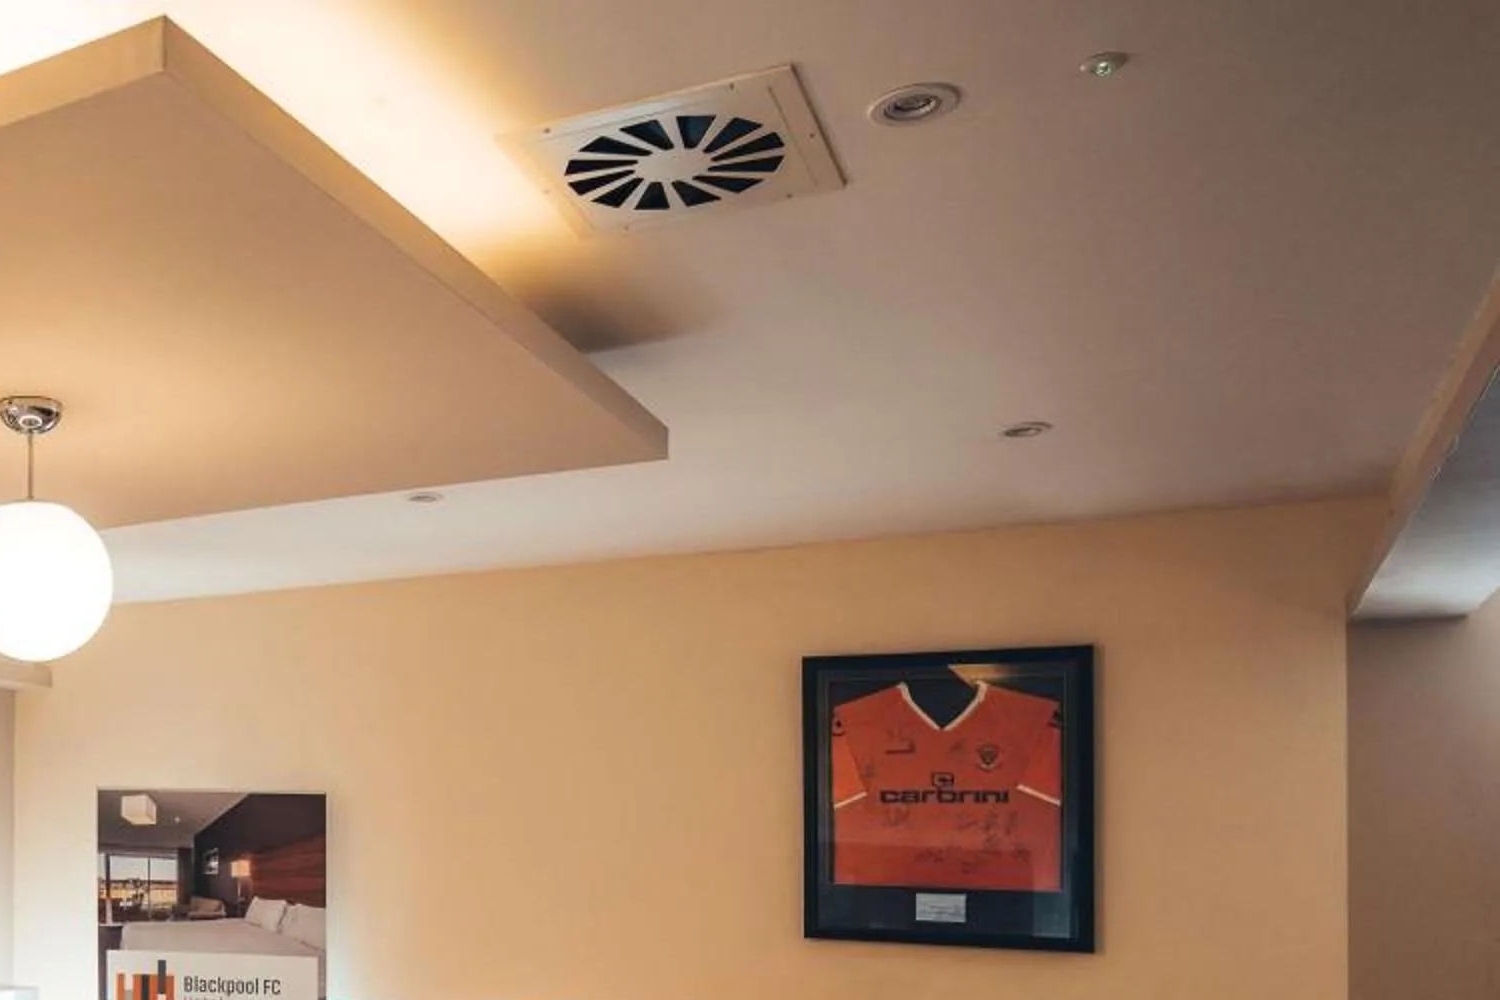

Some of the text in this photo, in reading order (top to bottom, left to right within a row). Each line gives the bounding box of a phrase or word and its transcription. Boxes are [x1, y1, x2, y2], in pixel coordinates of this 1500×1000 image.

[879, 784, 1010, 805] carbrini
[183, 975, 282, 997] Blackpool FC
